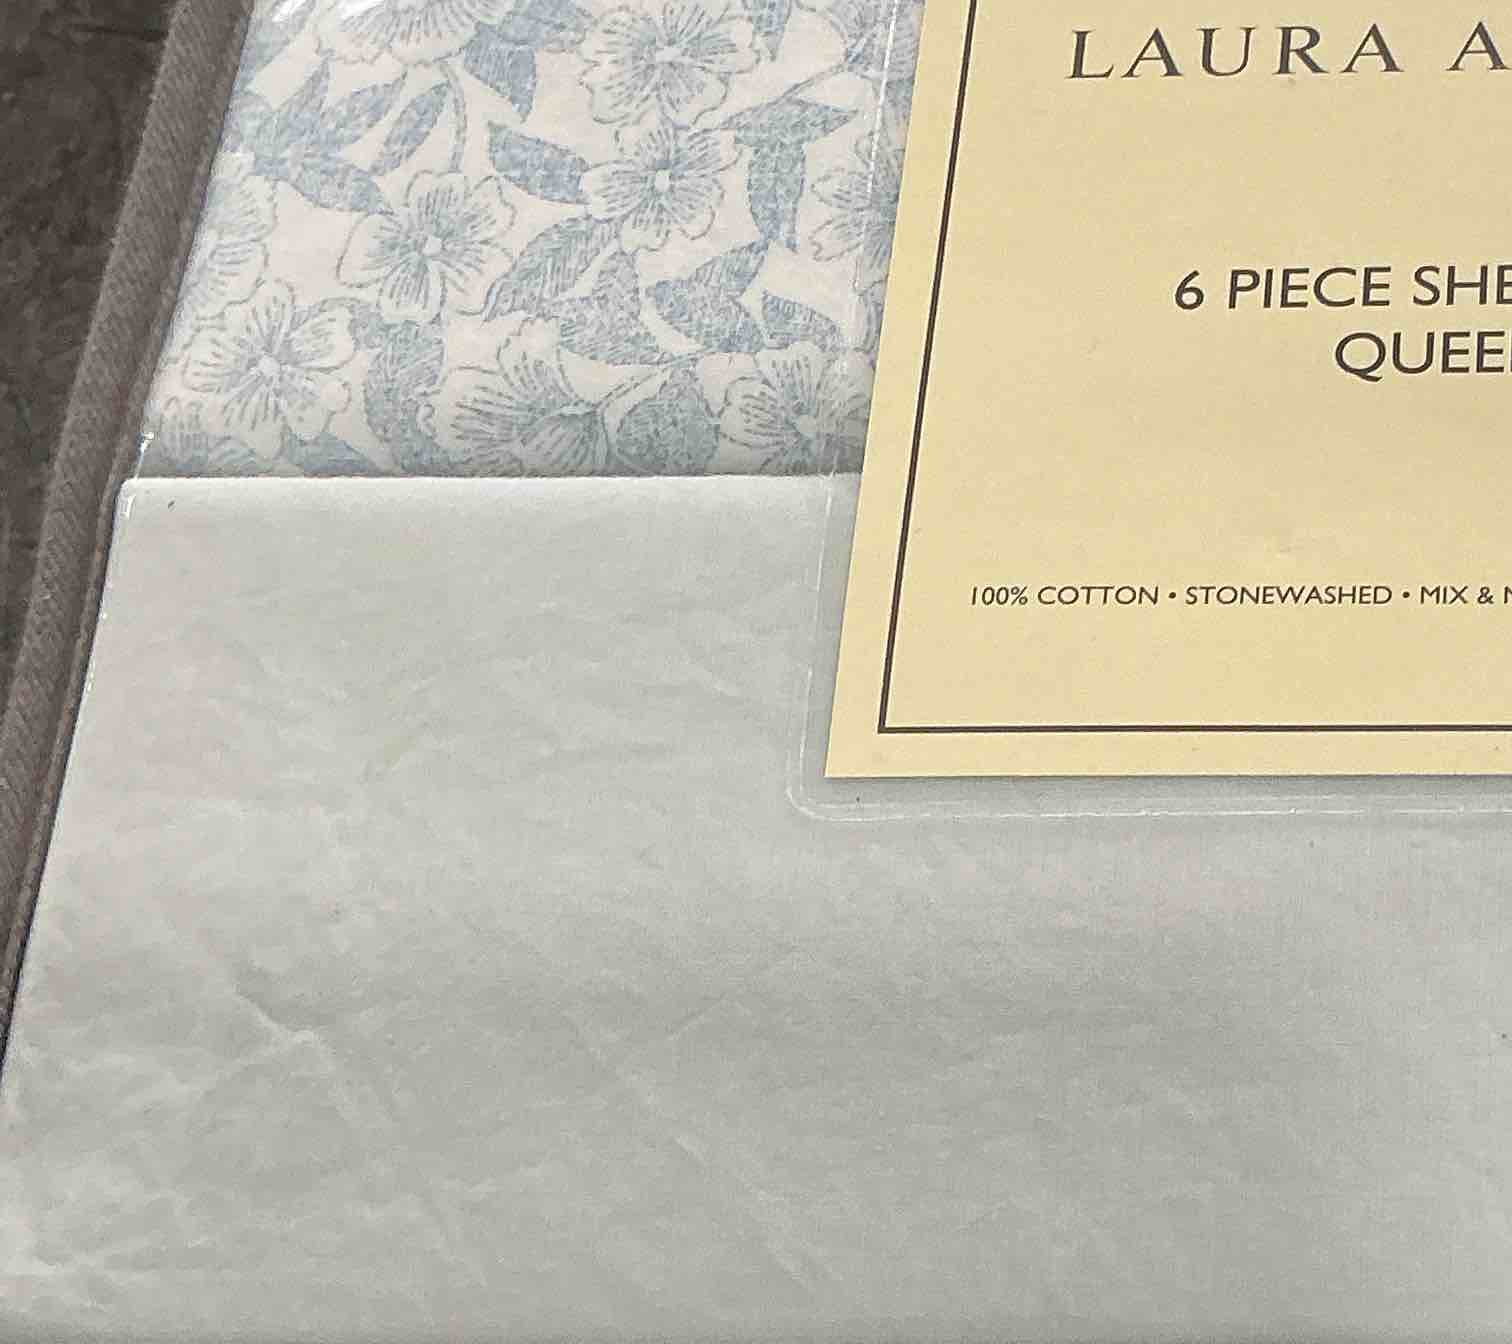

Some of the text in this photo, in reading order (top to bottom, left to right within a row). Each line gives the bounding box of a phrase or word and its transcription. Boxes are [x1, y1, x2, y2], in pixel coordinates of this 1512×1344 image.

[1065, 23, 1405, 80] LAURA
[1174, 269, 1205, 310] 6
[1228, 266, 1392, 309] PIECE
[971, 584, 1029, 606] 100%
[1037, 584, 1159, 606] COTTON
[1184, 584, 1393, 606] STONEWASHED
[1419, 584, 1469, 605] MIX
[1476, 585, 1495, 605] &
